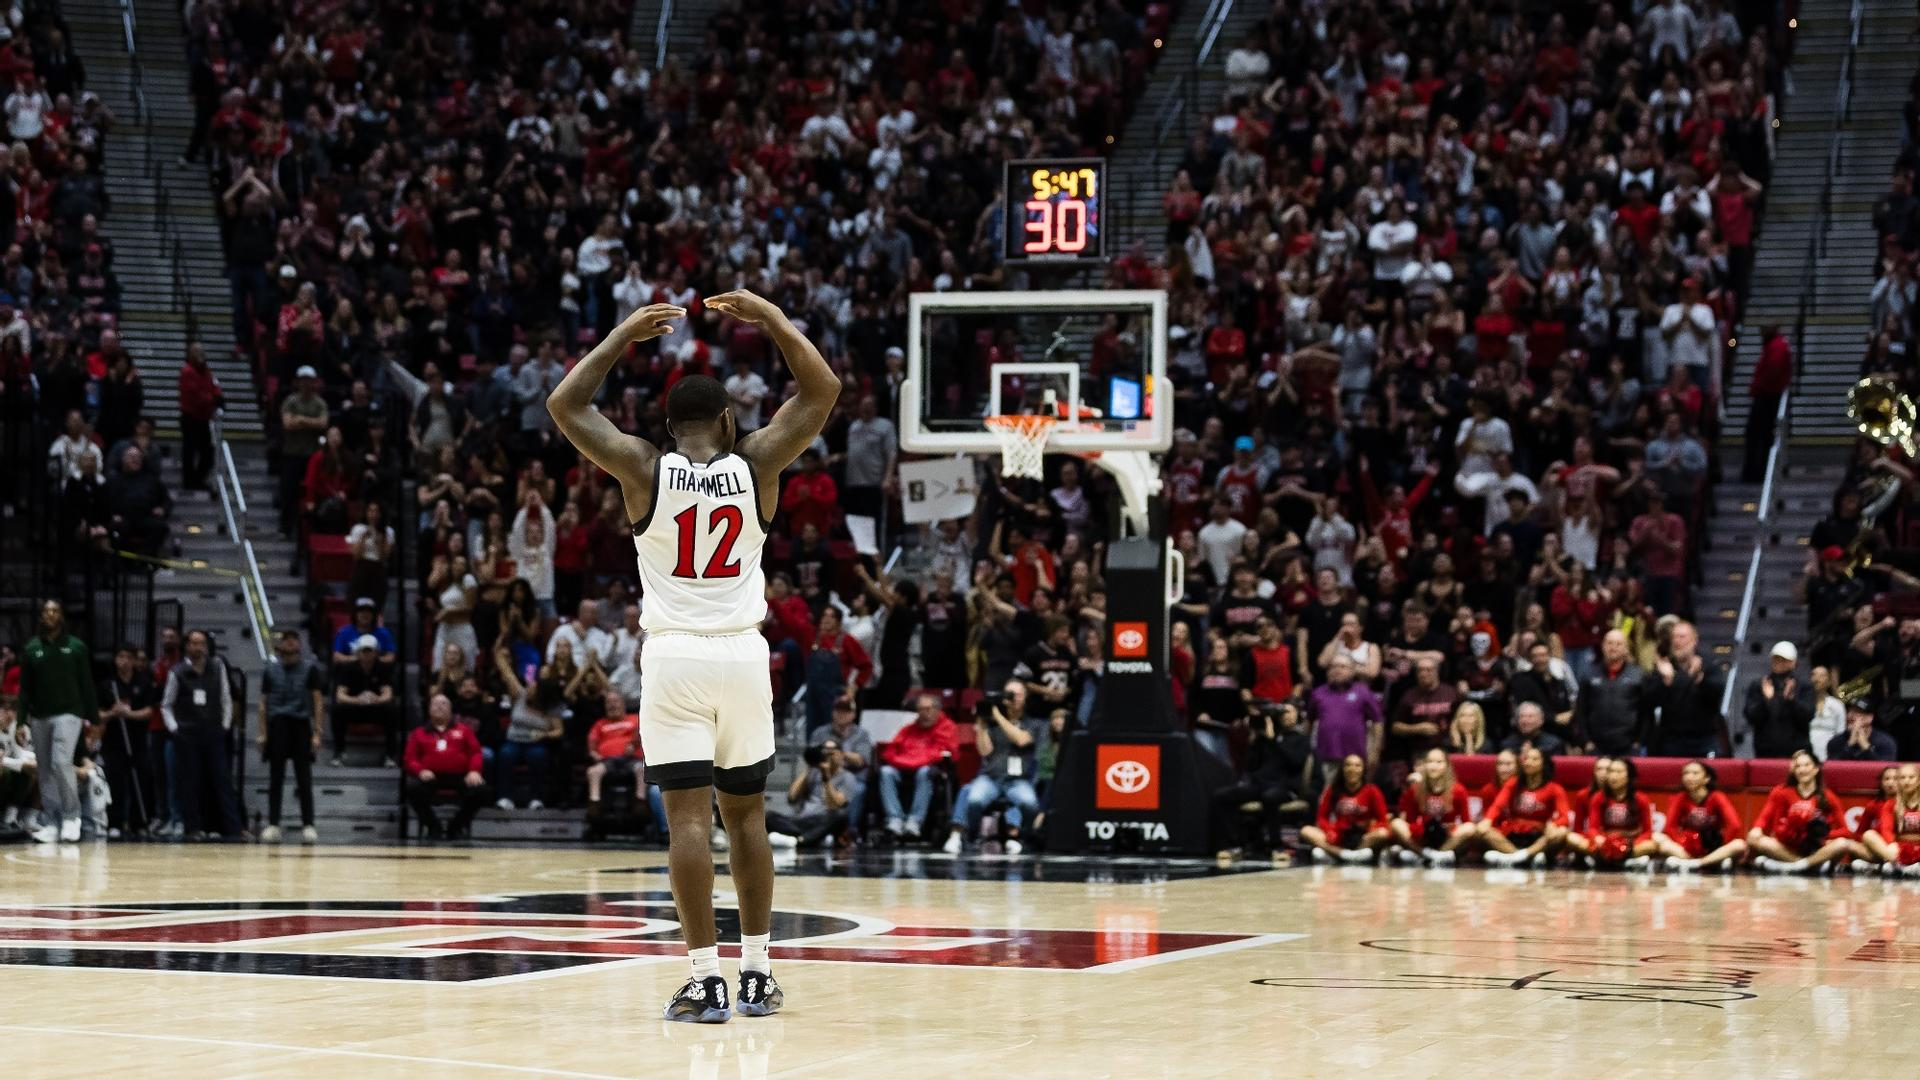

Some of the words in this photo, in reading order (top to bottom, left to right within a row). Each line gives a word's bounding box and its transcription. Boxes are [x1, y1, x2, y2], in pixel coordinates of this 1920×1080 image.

[1032, 168, 1096, 200] 5:47
[1025, 200, 1086, 252] 30
[671, 503, 743, 579] 12
[1085, 821, 1169, 840] TOTA
